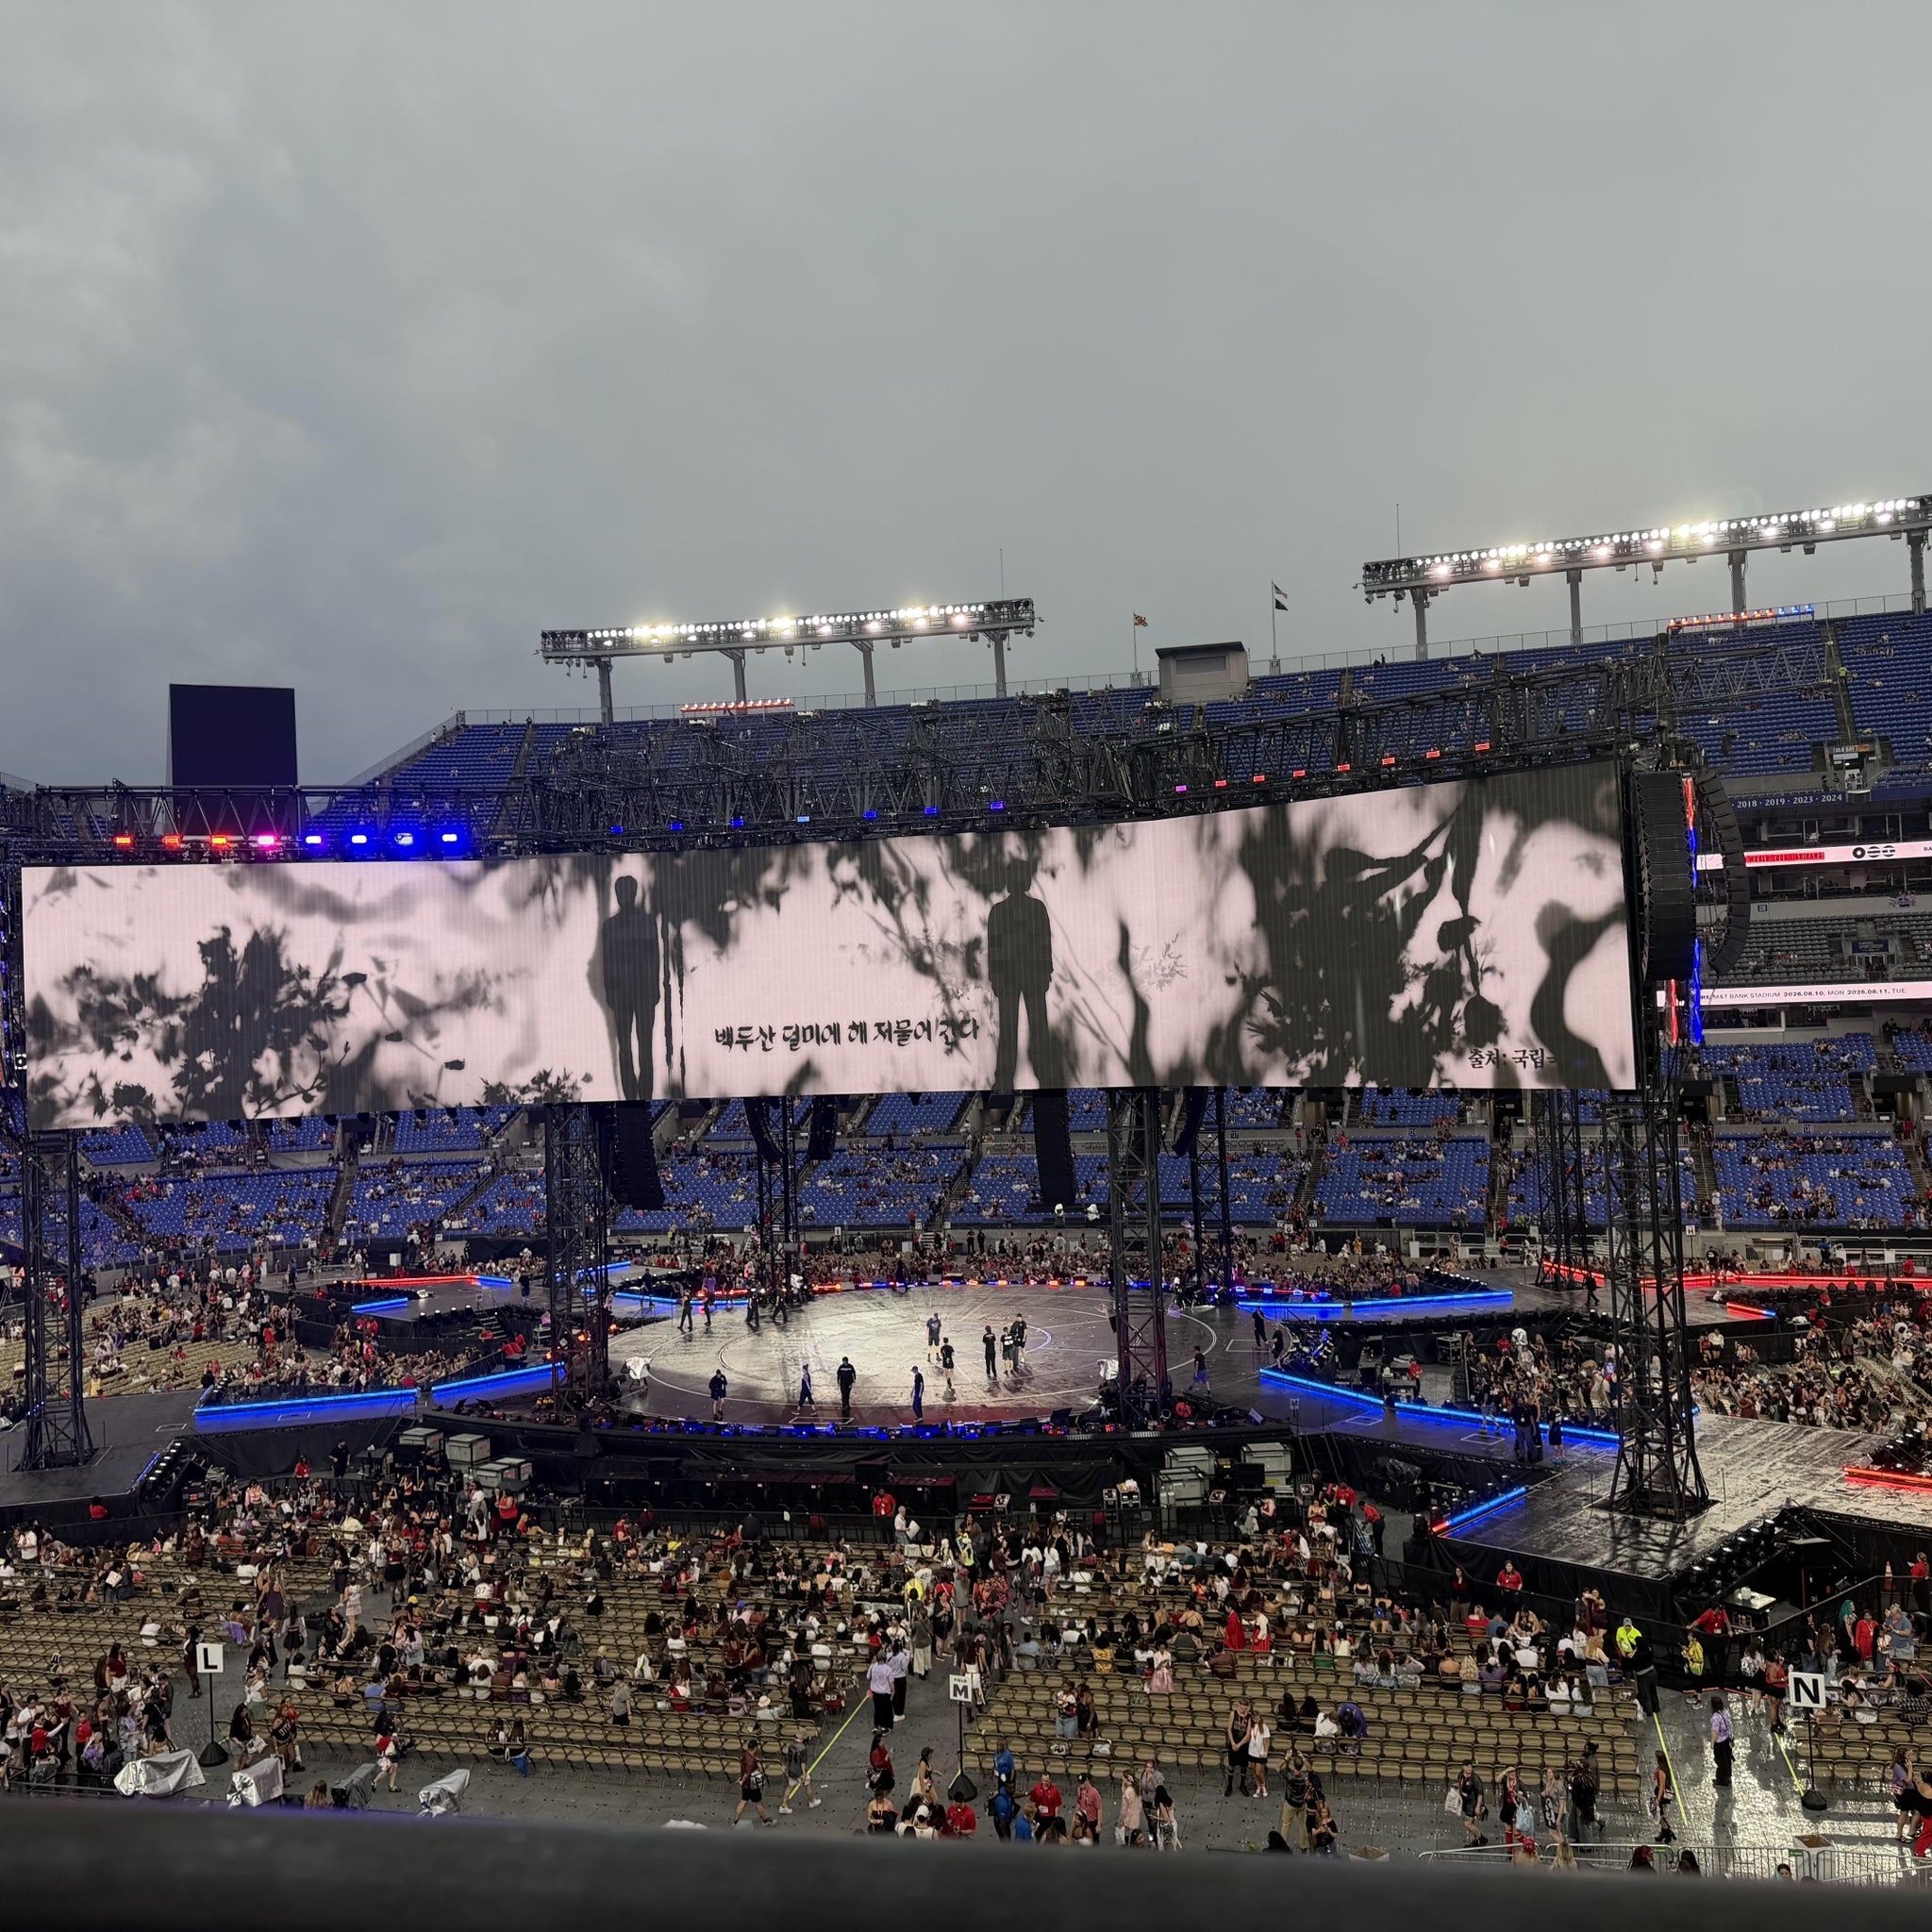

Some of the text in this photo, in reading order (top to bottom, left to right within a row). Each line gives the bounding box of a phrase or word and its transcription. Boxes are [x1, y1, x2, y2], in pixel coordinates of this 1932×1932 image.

[1737, 793, 1842, 808] 2018 2019 2023 2024
[715, 1024, 776, 1053] 백두산
[782, 1021, 841, 1052] 덜미에
[873, 1018, 932, 1047] 저물어
[1468, 1048, 1507, 1069] 출처:
[203, 1647, 218, 1670] L
[953, 1683, 969, 1699] M
[1793, 1676, 1821, 1705] N
